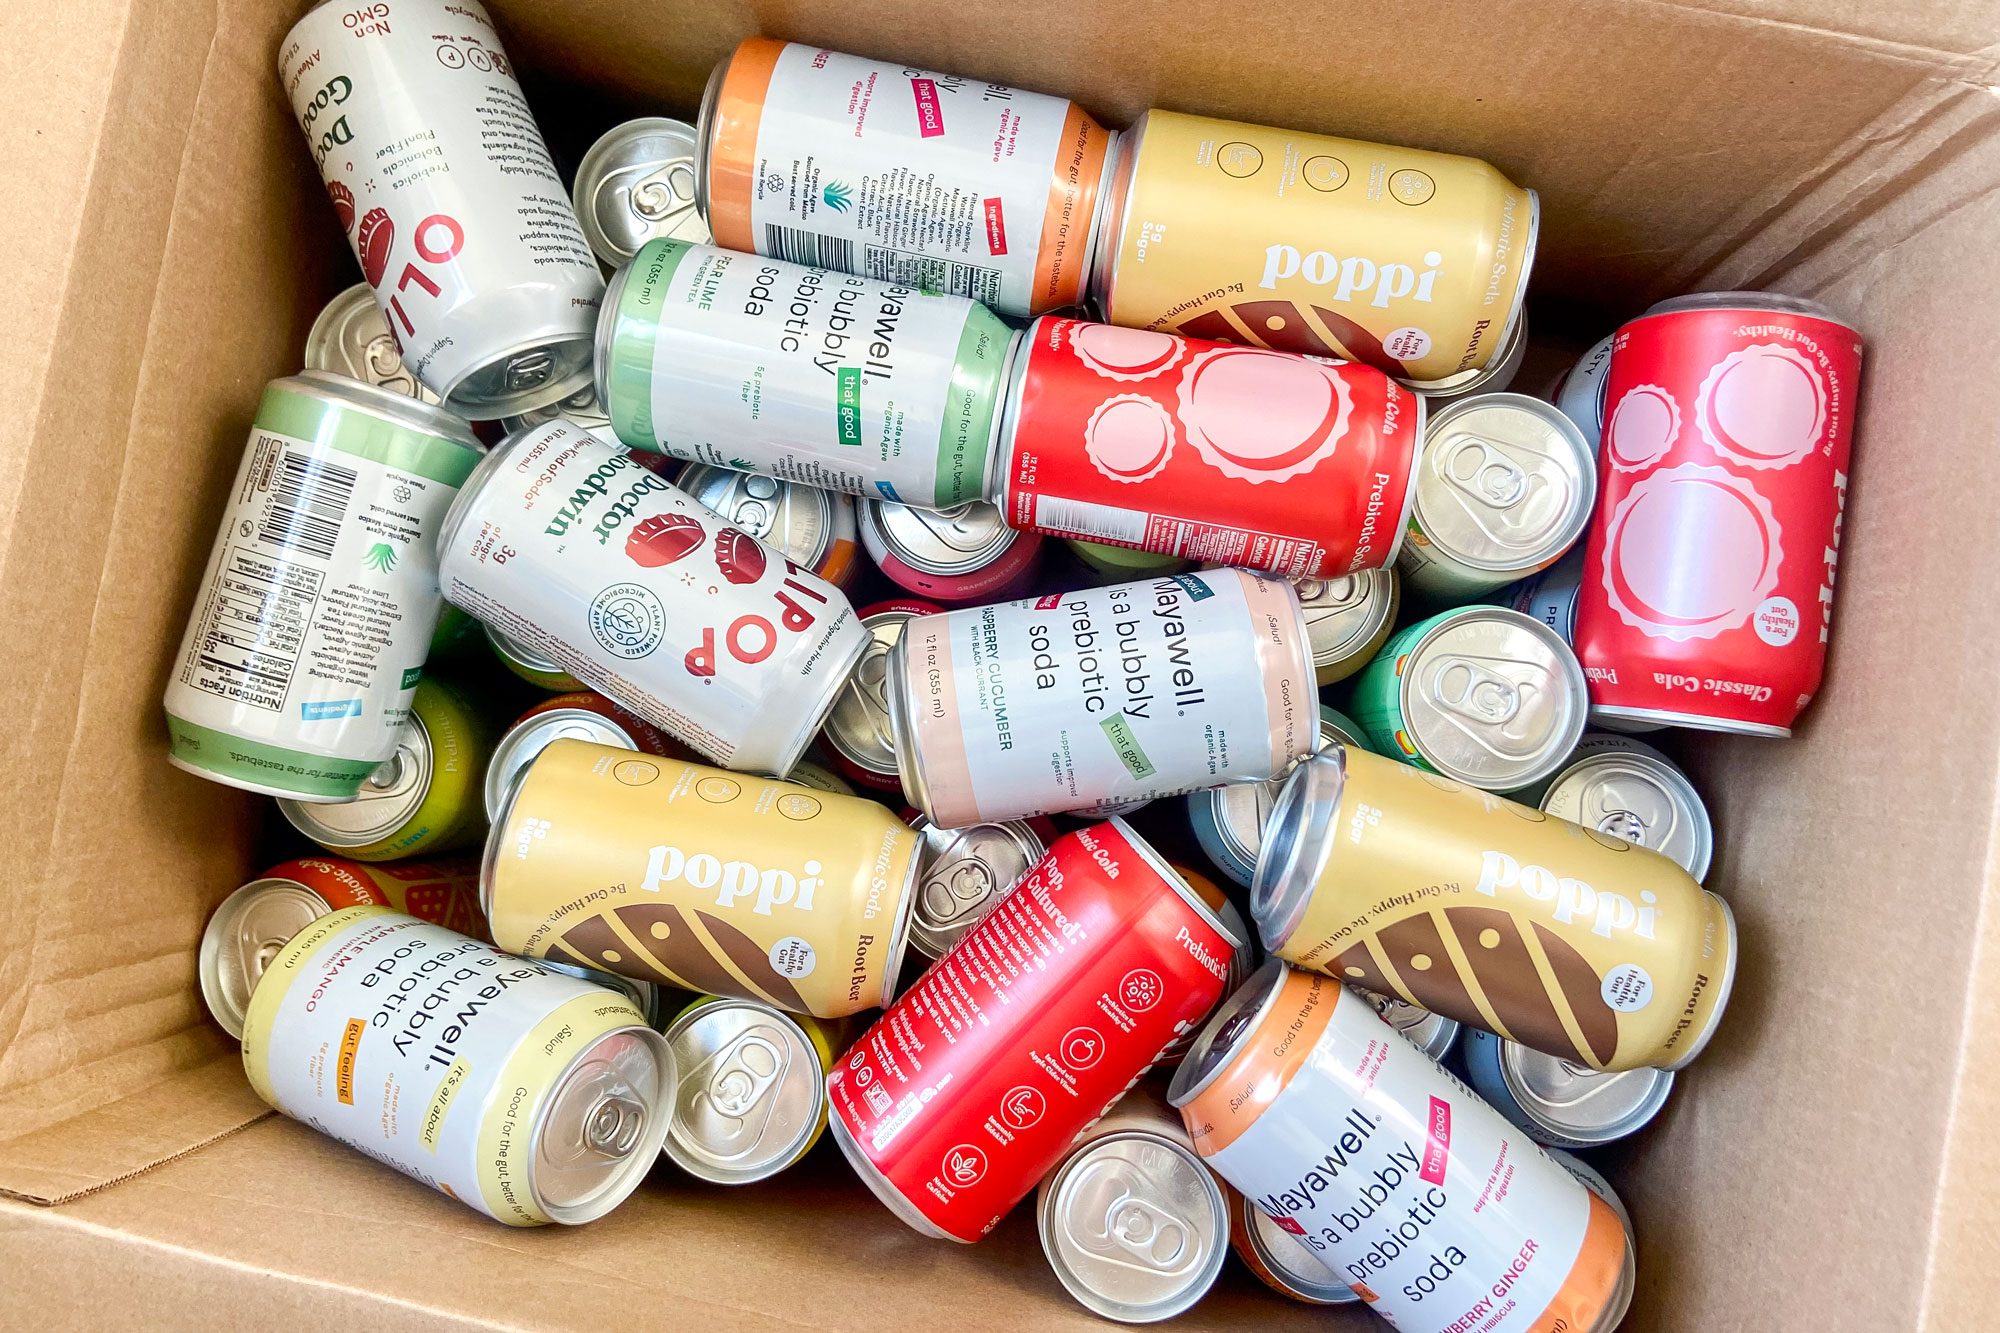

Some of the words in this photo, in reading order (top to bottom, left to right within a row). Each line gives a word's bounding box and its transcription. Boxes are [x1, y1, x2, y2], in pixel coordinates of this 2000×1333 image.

[342, 3, 390, 28] GMO
[354, 20, 390, 38] Non
[846, 81, 862, 114] digestion
[918, 84, 929, 99] that
[857, 98, 870, 127] improved
[920, 102, 936, 128] good
[1009, 115, 1021, 135] made
[404, 129, 434, 147] Plant
[1006, 137, 1016, 156] with
[376, 141, 403, 160] Fiber
[382, 146, 442, 175] Botanicals
[392, 162, 449, 190] Prebiotics
[1137, 221, 1153, 264] Sugar
[1151, 223, 1166, 243] 5g
[646, 263, 663, 285] (355
[690, 266, 706, 288] GREEN
[710, 256, 731, 278] PEAR
[1258, 242, 1444, 309] poppi
[698, 280, 719, 310] LIME
[744, 266, 780, 316] soda
[1202, 288, 1225, 300] Gut
[1484, 260, 1506, 307] Soda
[638, 287, 651, 305] ml)
[686, 289, 697, 303] TEA
[813, 289, 860, 374] bubbly
[1739, 321, 1795, 343] Healthy.
[1794, 333, 1818, 352] Gut
[1391, 337, 1402, 350] Gut
[741, 381, 751, 402] fiber
[843, 375, 855, 404] that
[748, 385, 763, 420] prebiotic
[882, 400, 895, 427] organic
[961, 393, 976, 417] Good
[843, 408, 856, 437] good
[895, 416, 904, 435] made
[960, 419, 971, 431] for
[1381, 401, 1397, 435] Cola
[880, 430, 891, 461] Agave
[893, 438, 901, 456] with
[956, 435, 967, 452] the
[554, 449, 576, 467] Kind
[952, 453, 963, 471] gut,
[545, 463, 561, 477] of
[592, 474, 669, 538] Doctor
[1357, 472, 1388, 544] Prebiotic
[475, 521, 494, 539] per
[490, 526, 503, 538] of
[470, 539, 484, 557] can
[473, 537, 495, 563] sugar
[492, 545, 516, 565] 3g
[596, 588, 645, 610] MICROBIOME
[1109, 587, 1132, 599] is
[650, 604, 660, 632] PLANT
[1112, 603, 1131, 615] a
[1771, 605, 1787, 616] Gut
[594, 610, 614, 649] APPROVED
[1758, 614, 1795, 628] Healthy
[1773, 626, 1787, 636] For
[625, 633, 658, 654] POWERED
[926, 634, 936, 643] 12
[970, 625, 978, 641] WITH
[202, 638, 218, 653] 35
[972, 642, 981, 665] BLACK
[1061, 600, 1105, 713] prebiotic
[259, 655, 292, 671] Calories
[927, 654, 936, 665] oz
[1028, 625, 1060, 690] soda
[927, 668, 942, 694] (355
[982, 610, 999, 659] RASPBERRY
[991, 685, 1013, 751] CUCUMBER
[1115, 620, 1154, 719] bubbly
[198, 677, 226, 693] Facts
[975, 667, 988, 711] CURRANT
[1280, 679, 1292, 706] Good
[1651, 673, 1699, 692] Cola
[1703, 678, 1771, 701] Classic
[228, 686, 281, 710] Nutrition
[932, 698, 946, 718] ml)
[1282, 707, 1294, 721] for
[1110, 723, 1130, 749] that
[1122, 749, 1148, 774] good
[1204, 724, 1216, 754] organic
[1218, 730, 1227, 751] made
[229, 751, 283, 772] tastebuds.
[285, 765, 303, 774] the
[1051, 752, 1063, 786] digestion
[1060, 730, 1072, 766] supports
[1067, 768, 1078, 797] improved
[1207, 755, 1217, 775] Agave
[1220, 750, 1229, 768] with
[1038, 856, 1073, 891] Pop,
[1091, 845, 1124, 880] Cola
[640, 845, 824, 916] poppi
[1417, 881, 1441, 902] Gut
[1444, 880, 1461, 895] Be
[586, 884, 608, 906] Gut
[863, 876, 888, 921] Soda
[1476, 850, 1657, 940] poppi
[1351, 913, 1369, 930] Be
[1329, 923, 1353, 946] Gut
[778, 949, 788, 965] Gut
[784, 941, 799, 974] Healthy
[797, 950, 808, 964] For
[853, 934, 874, 973] Root
[1175, 927, 1221, 971] Prebiotic
[360, 940, 427, 988] soda
[306, 955, 351, 1013] MANGO
[380, 941, 481, 1028] prebiotic
[848, 975, 867, 1001] Beer
[1610, 976, 1623, 994] Gut
[1615, 969, 1637, 1007] Healthy
[1632, 980, 1645, 996] For
[1688, 973, 1708, 1015] Root
[392, 967, 481, 1058] bubbly
[347, 1023, 359, 1046] gut
[1273, 1031, 1296, 1057] Good
[1290, 1018, 1304, 1032] for
[1299, 1004, 1313, 1018] the
[1028, 1049, 1047, 1067] Apple
[1043, 1053, 1066, 1074] Infused
[339, 1052, 353, 1098] feeling
[437, 1087, 453, 1105] all
[506, 1087, 527, 1119] Good
[421, 1105, 445, 1143] about
[502, 1120, 516, 1138] for
[987, 1114, 1016, 1143] Immunity
[1429, 1103, 1449, 1141] good
[982, 1121, 1009, 1147] Sidekick
[495, 1140, 512, 1158] the
[491, 1159, 512, 1177] gut,
[925, 1180, 950, 1205] Caffeine
[930, 1175, 955, 1199] Natural
[1331, 1141, 1421, 1233] bubbly
[1492, 1164, 1515, 1202] digestion
[1321, 1224, 1342, 1246] a
[1345, 1187, 1447, 1286] prebiotic
[1403, 1246, 1467, 1302] soda
[1492, 1239, 1539, 1298] GINGER
[1481, 1301, 1516, 1333] HIBISCUS
